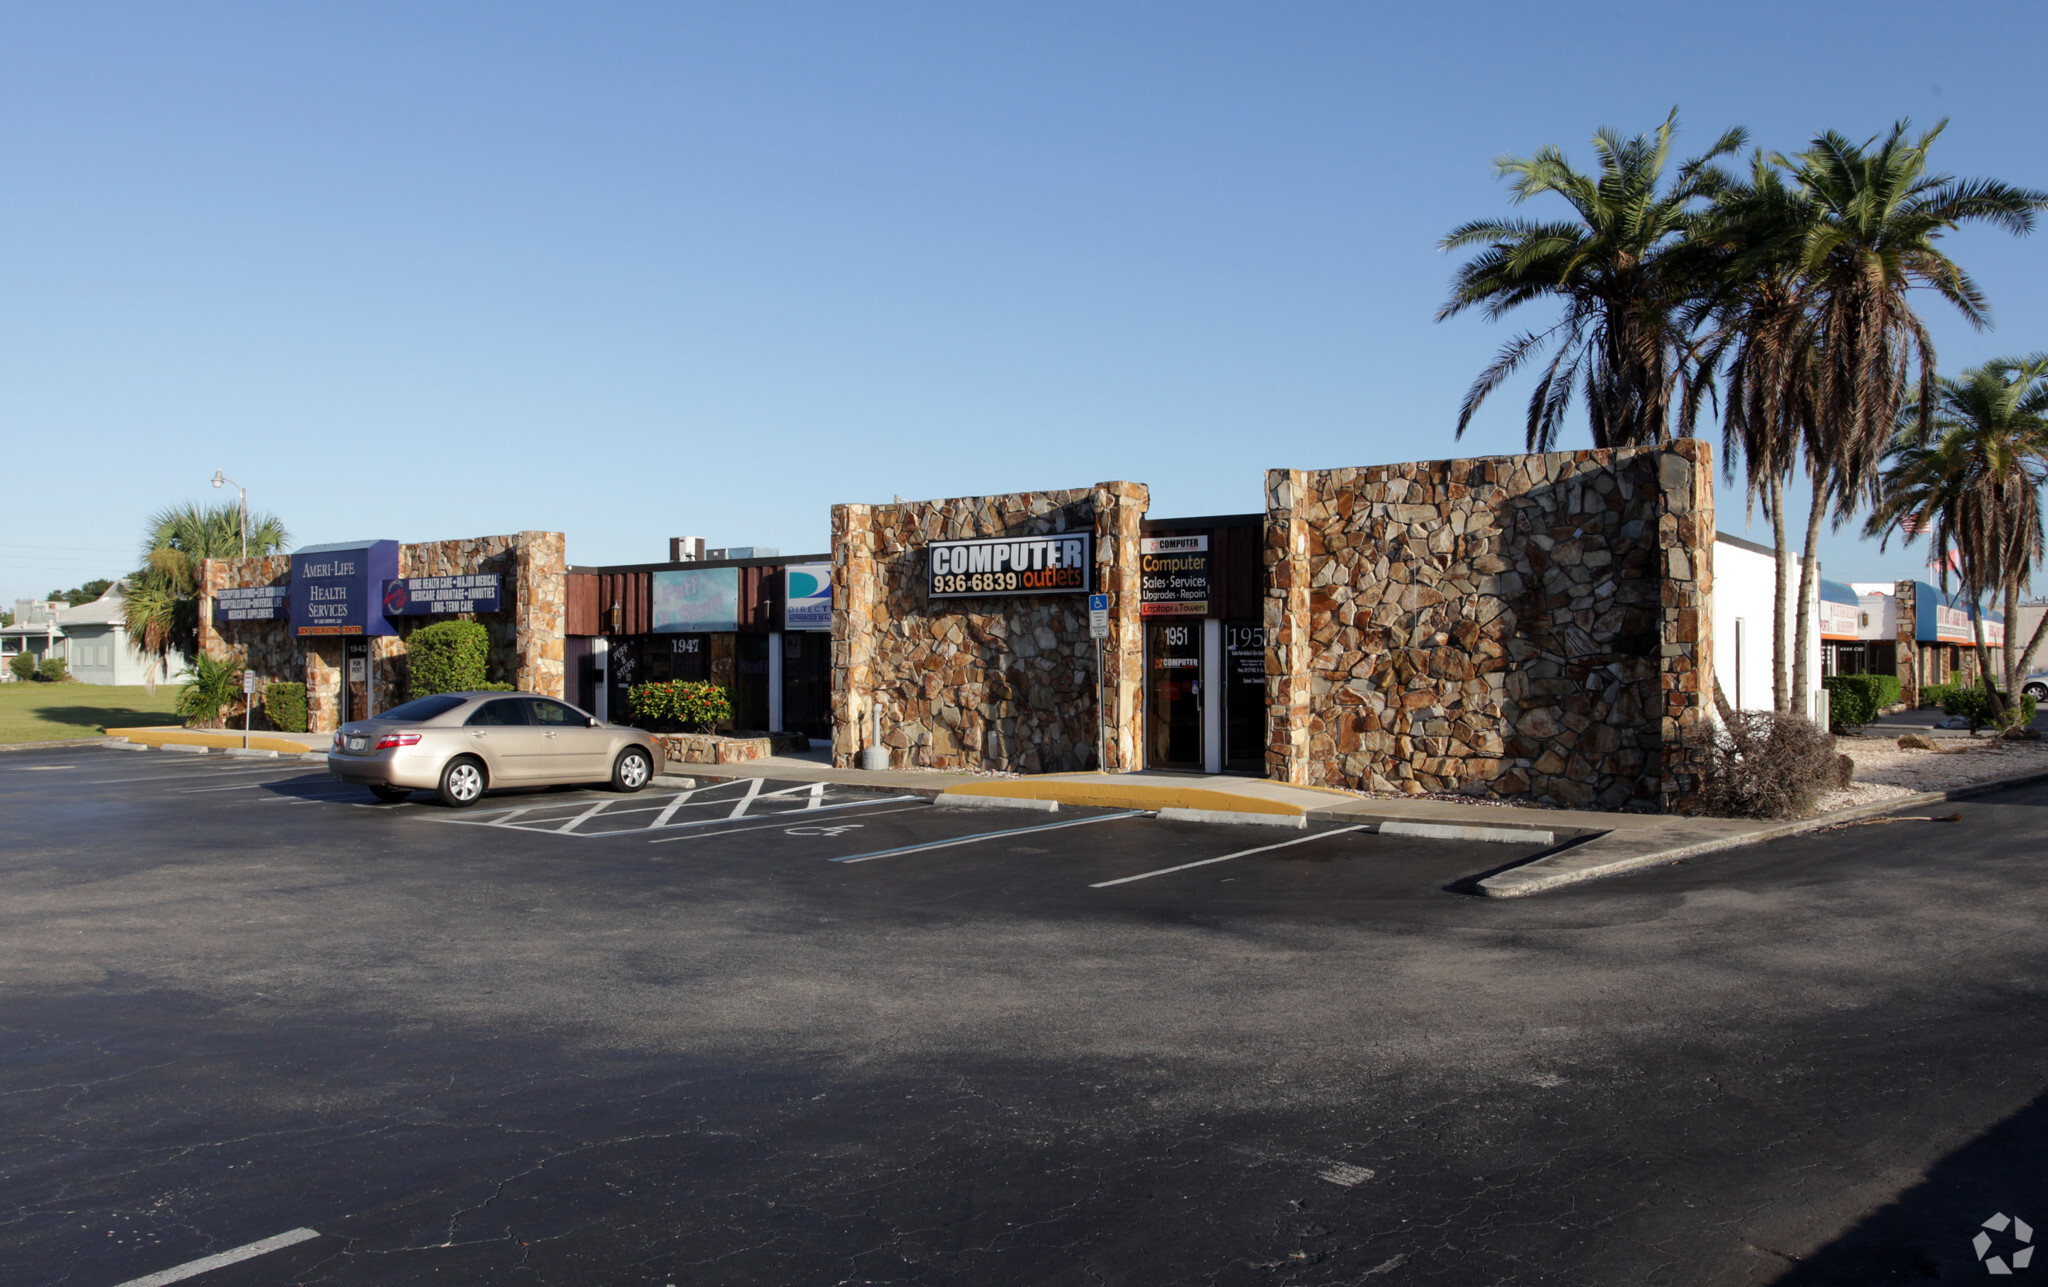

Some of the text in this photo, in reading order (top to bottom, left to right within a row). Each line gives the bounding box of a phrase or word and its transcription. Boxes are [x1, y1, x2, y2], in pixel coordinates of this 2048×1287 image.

[1160, 538, 1199, 549] COMPUTER
[933, 540, 1082, 575] COMPUTER
[1143, 555, 1206, 574] Computer
[409, 579, 422, 590] HOME
[423, 577, 440, 589] HEALTH
[440, 577, 453, 588] CARE
[456, 576, 474, 588] MAJOR
[475, 574, 498, 586] MEDICAL
[1023, 564, 1081, 588] outlets
[1143, 575, 1206, 589] Sales Services
[310, 586, 347, 601] HEALTH
[411, 587, 495, 602] MEDICARE ADVANTAGE ANNUITIES
[662, 574, 699, 603] Puff
[1143, 589, 1206, 601] Upgrades Repairs
[274, 597, 282, 607] LIFE
[431, 600, 474, 613] LONG-TERM CARE
[1143, 604, 1173, 614] Laptops
[1179, 603, 1205, 612] Towers
[308, 603, 348, 617] SERVICES
[311, 626, 340, 635] RECRUITING
[342, 625, 362, 635] CENTER
[1165, 627, 1188, 646] 1951
[1229, 628, 1264, 648] 195
[613, 643, 628, 661] PUFF
[671, 639, 699, 653] 1947
[616, 658, 636, 679] STUFF
[1163, 658, 1198, 667] COMPUTER
